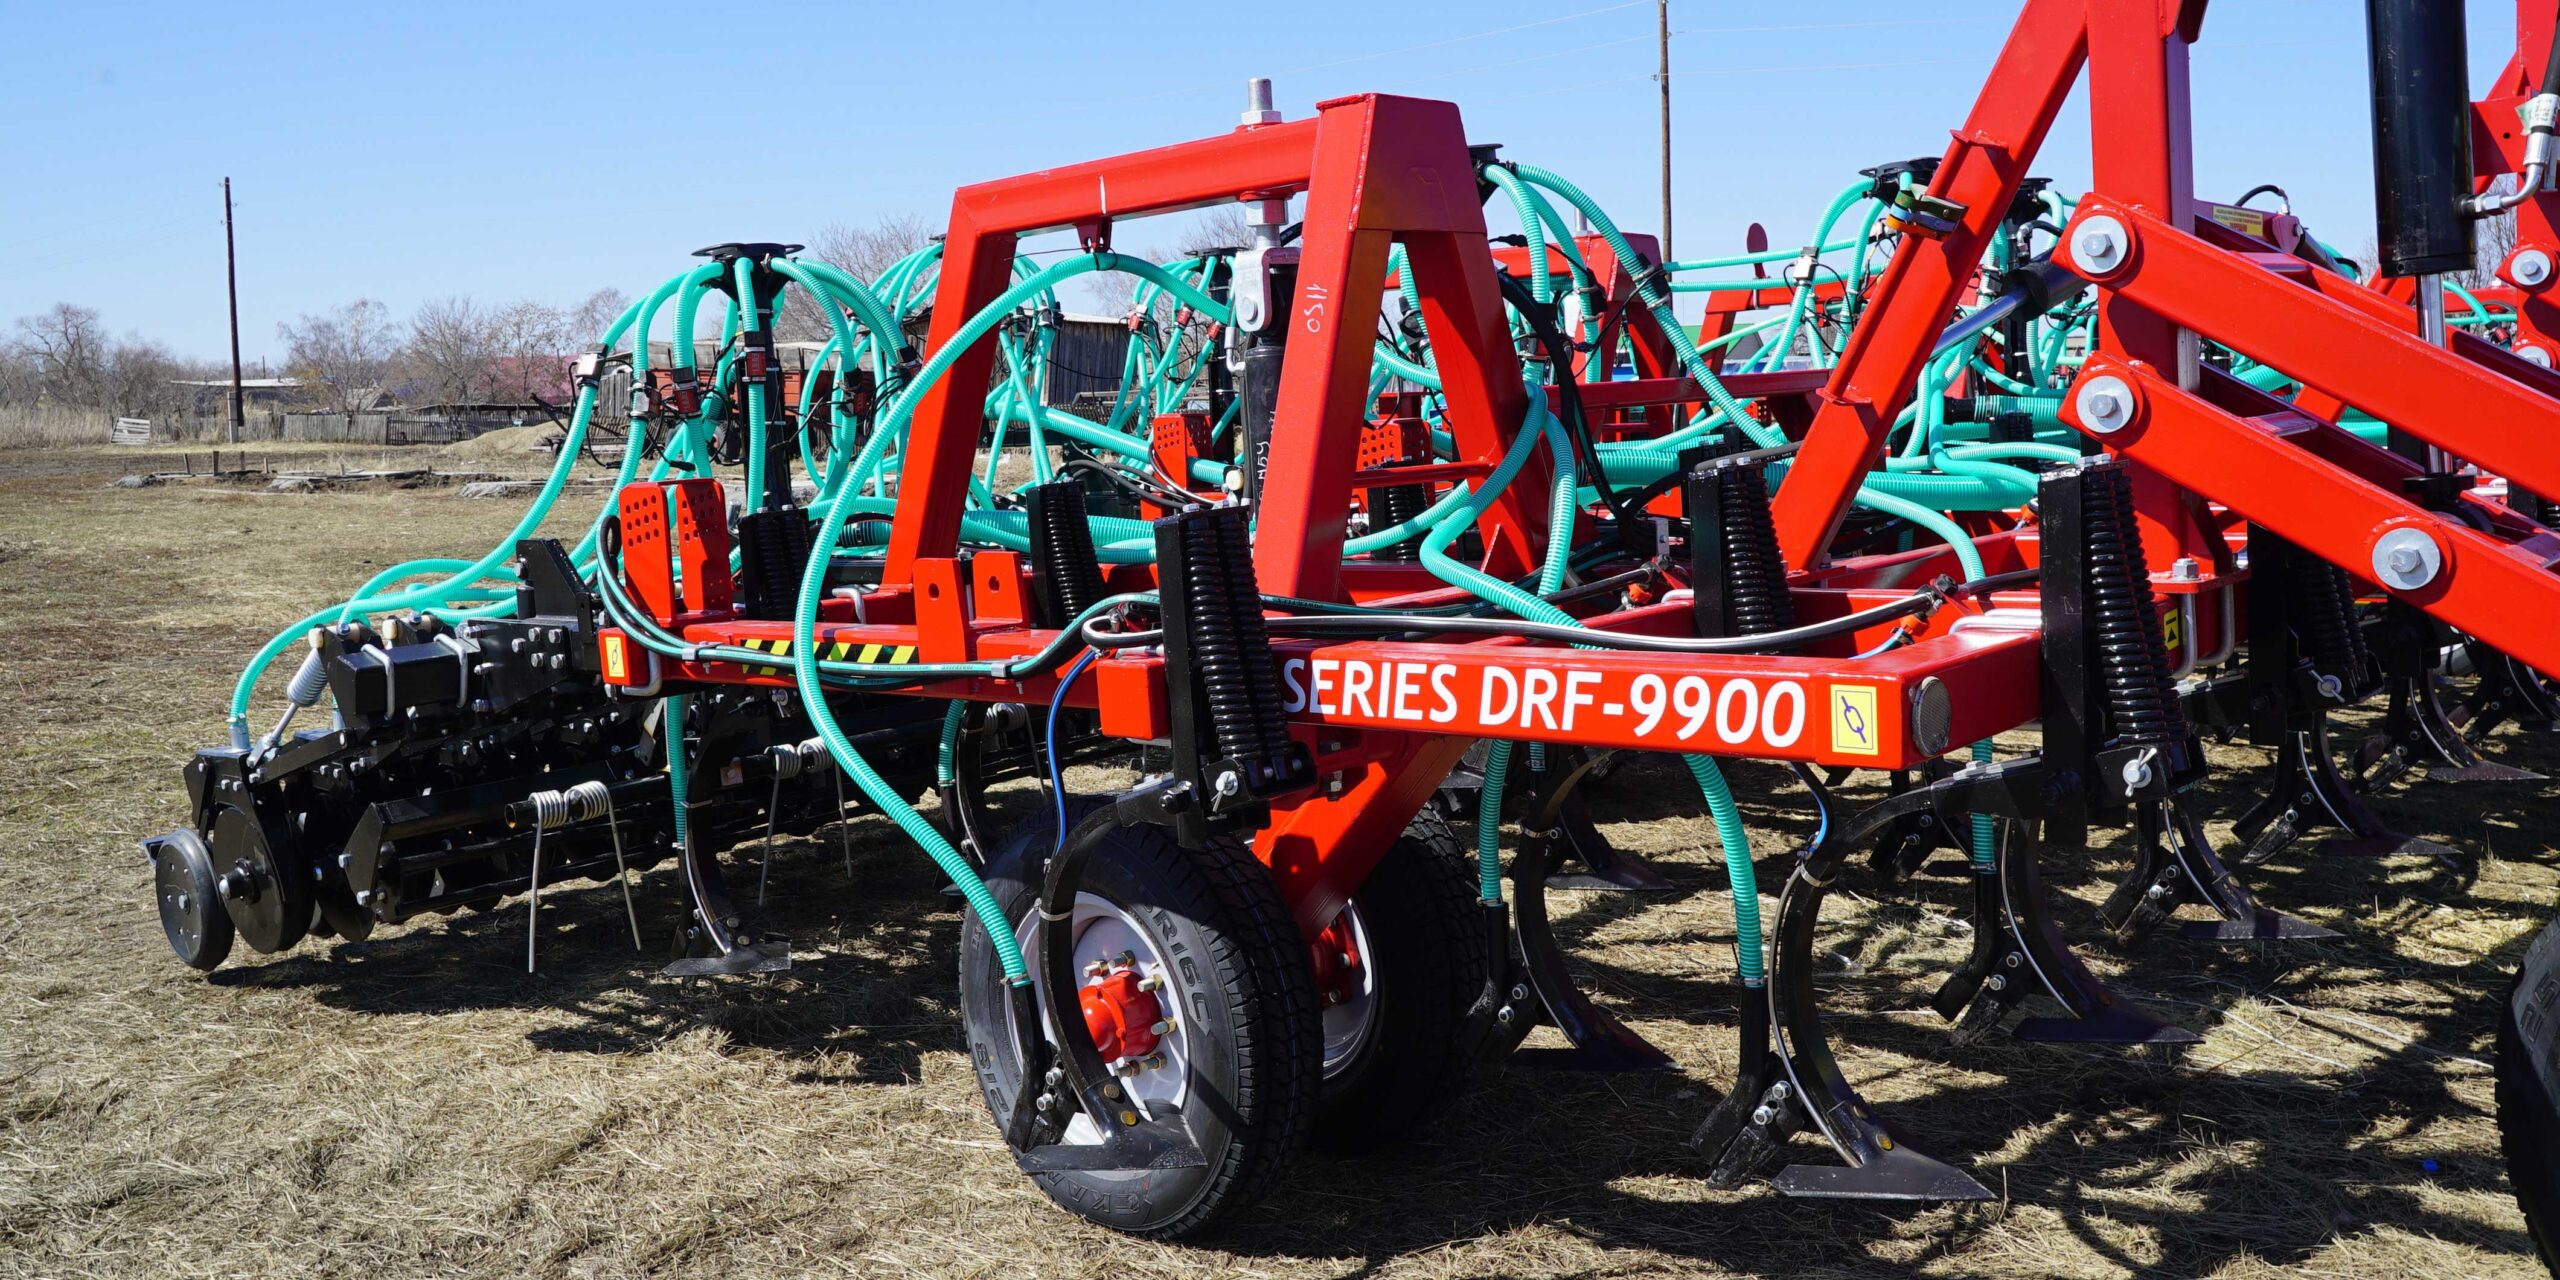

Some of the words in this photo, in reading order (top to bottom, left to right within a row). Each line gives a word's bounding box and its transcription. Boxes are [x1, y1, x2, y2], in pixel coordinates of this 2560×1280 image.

[1303, 283, 1328, 333] 1150
[1283, 658, 1458, 723] SERIES
[1479, 665, 1806, 748] DRF-9900
